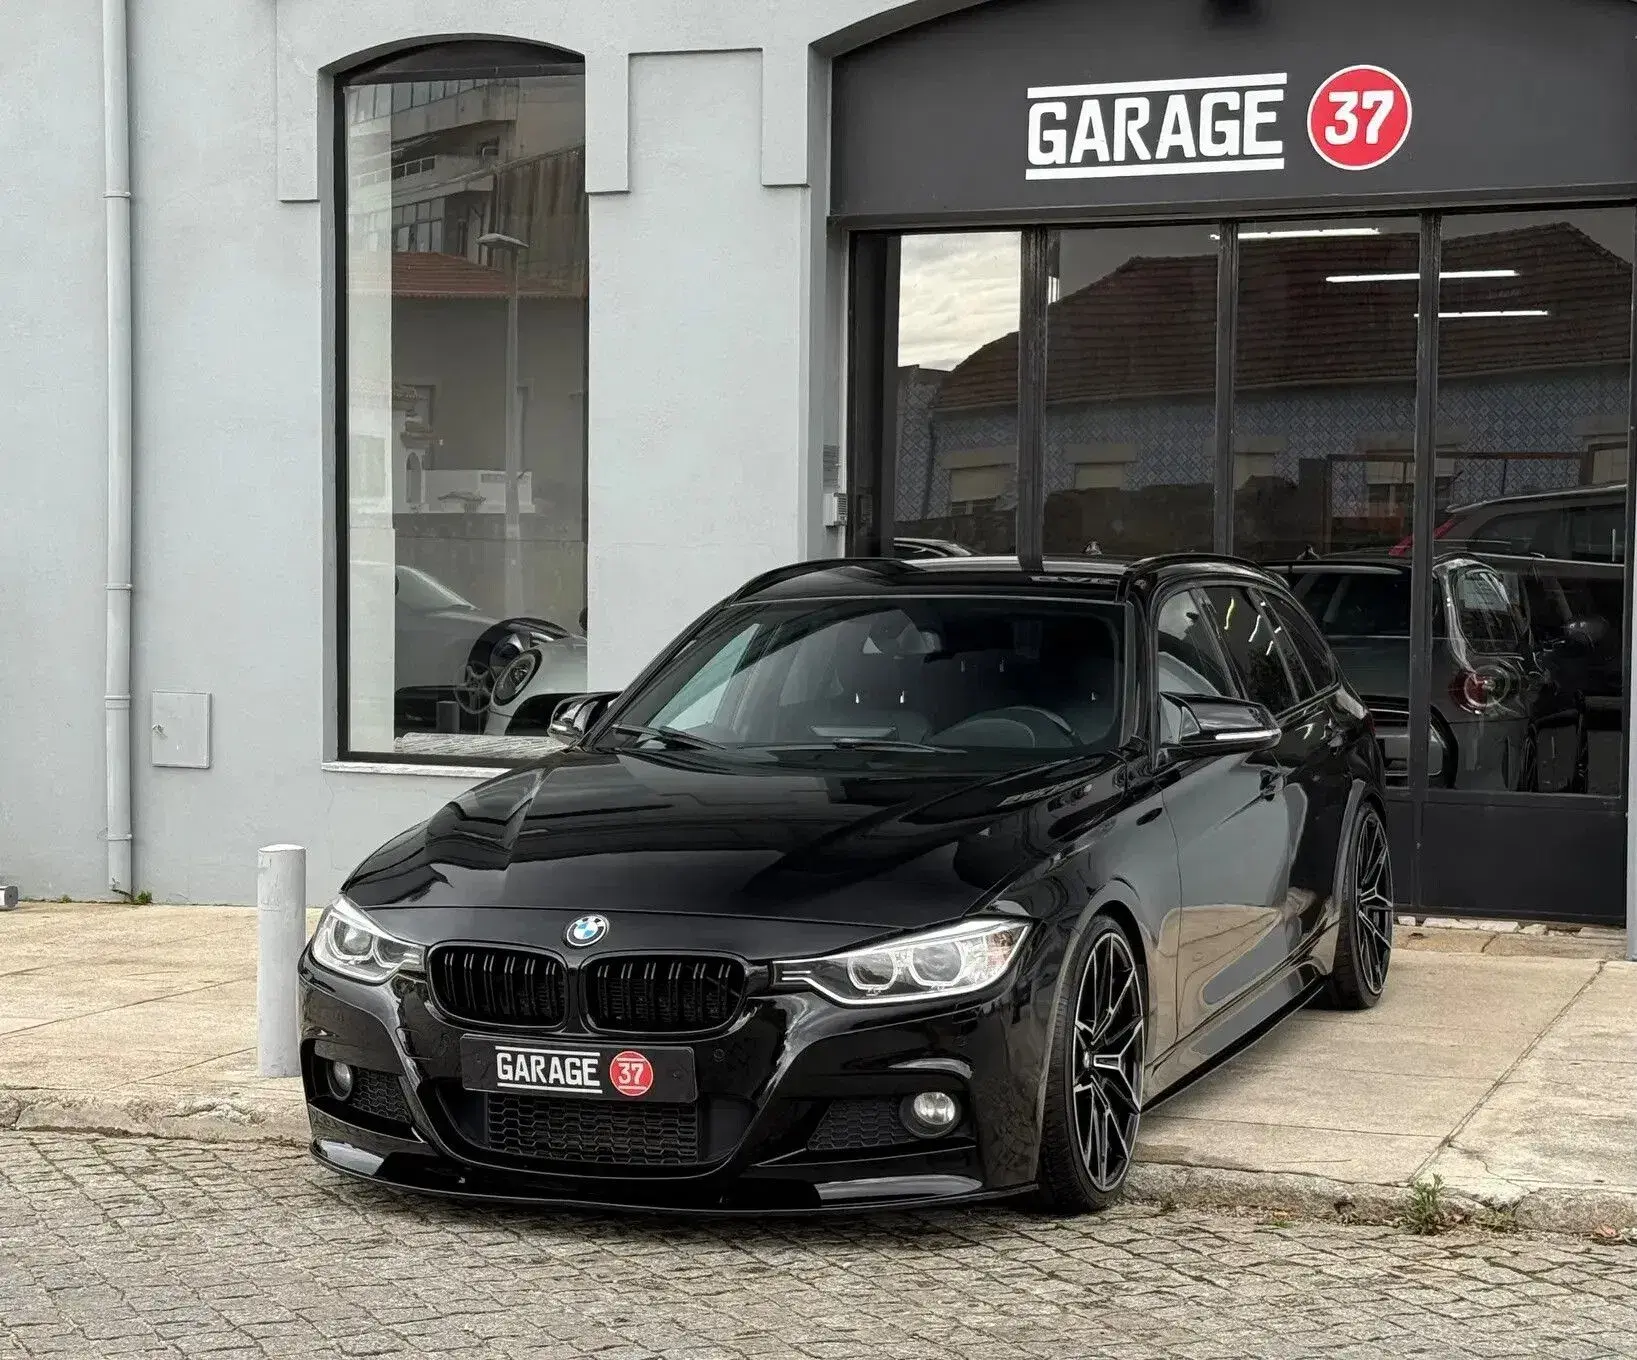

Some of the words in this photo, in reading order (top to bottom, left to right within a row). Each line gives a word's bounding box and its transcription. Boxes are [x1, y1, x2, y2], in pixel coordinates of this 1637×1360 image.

[1027, 88, 1284, 165] GARAGE
[1324, 90, 1394, 145] 37
[496, 1052, 601, 1087] GARAGE
[618, 1062, 644, 1085] 37
